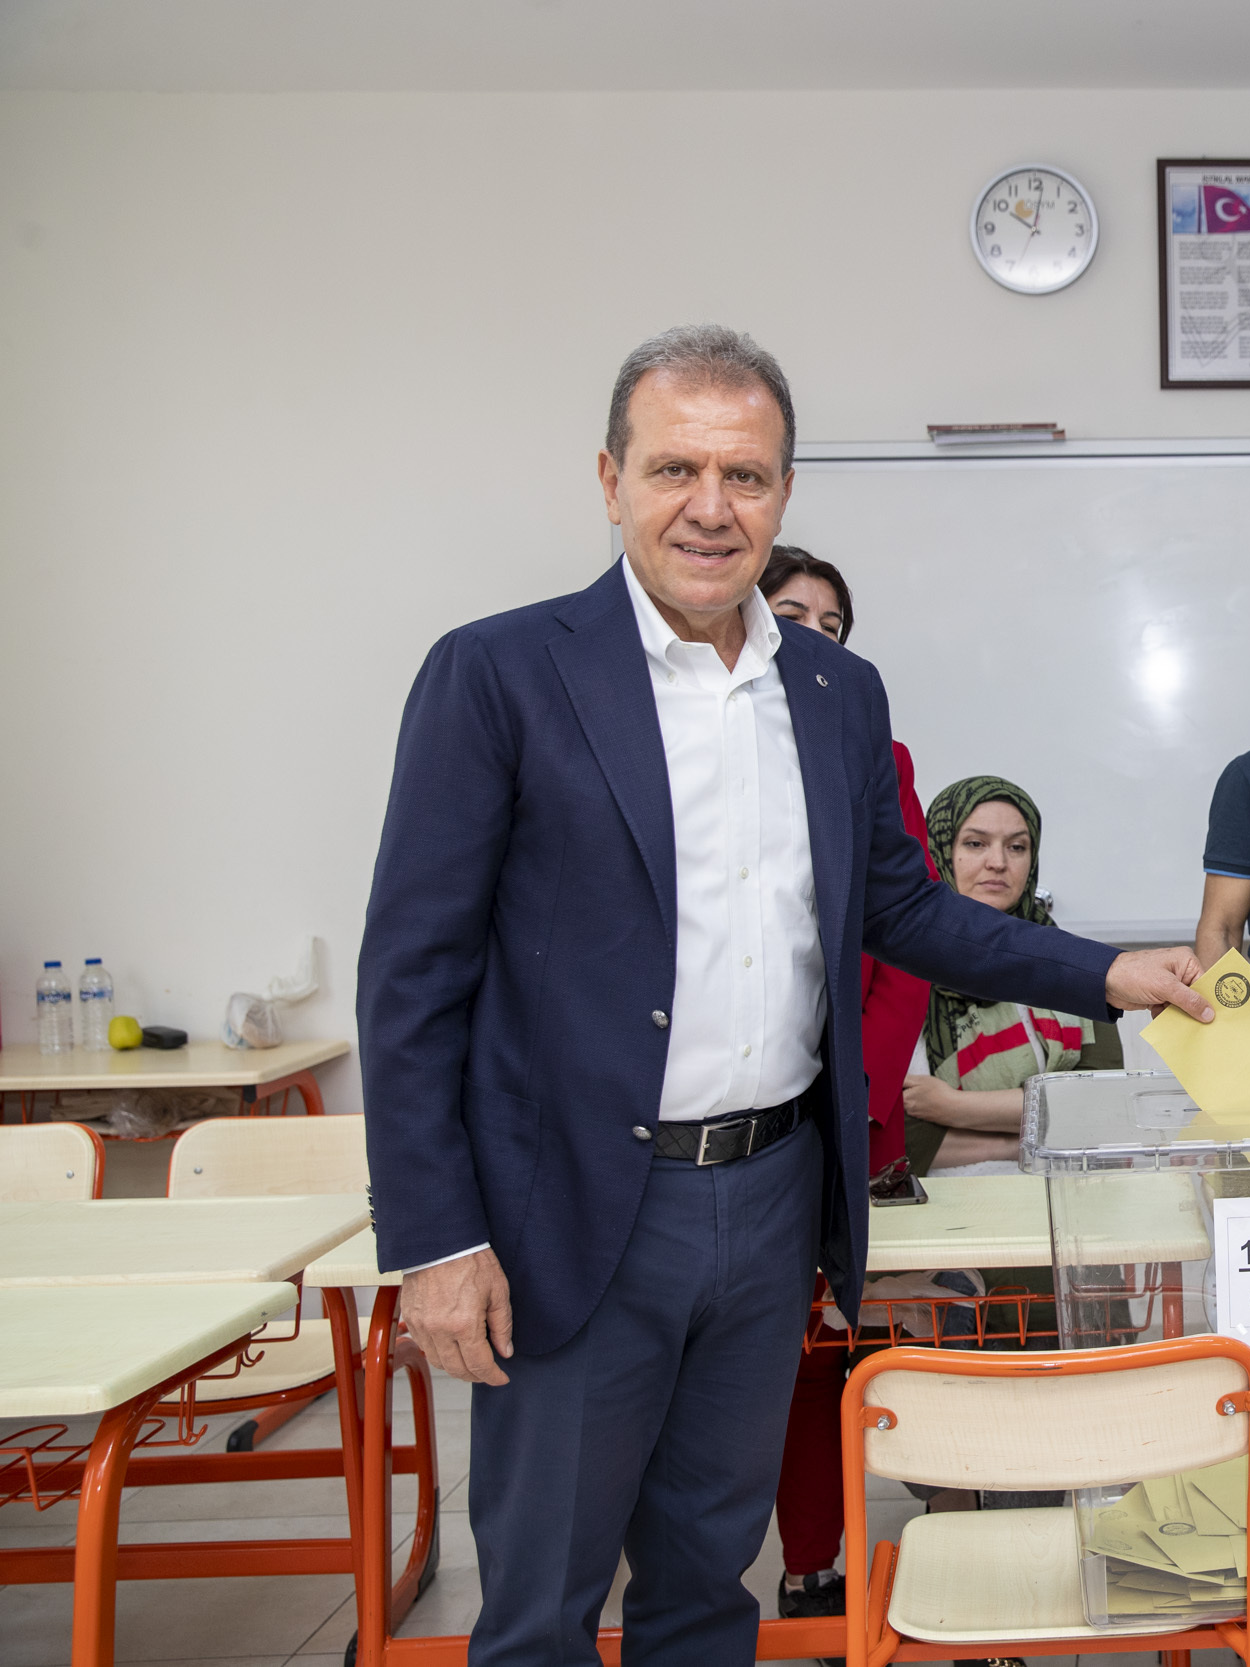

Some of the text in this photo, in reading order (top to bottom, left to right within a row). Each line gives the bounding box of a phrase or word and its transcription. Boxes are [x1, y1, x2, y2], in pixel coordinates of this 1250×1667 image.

[1008, 184, 1018, 198] 11
[1028, 177, 1043, 191] 12
[1056, 184, 1060, 198] 1
[993, 199, 1009, 212] 10
[1067, 201, 1078, 214] 2
[984, 221, 996, 235] 9
[1074, 223, 1085, 237] 3
[990, 244, 1002, 258] 8
[1068, 245, 1077, 258] 4
